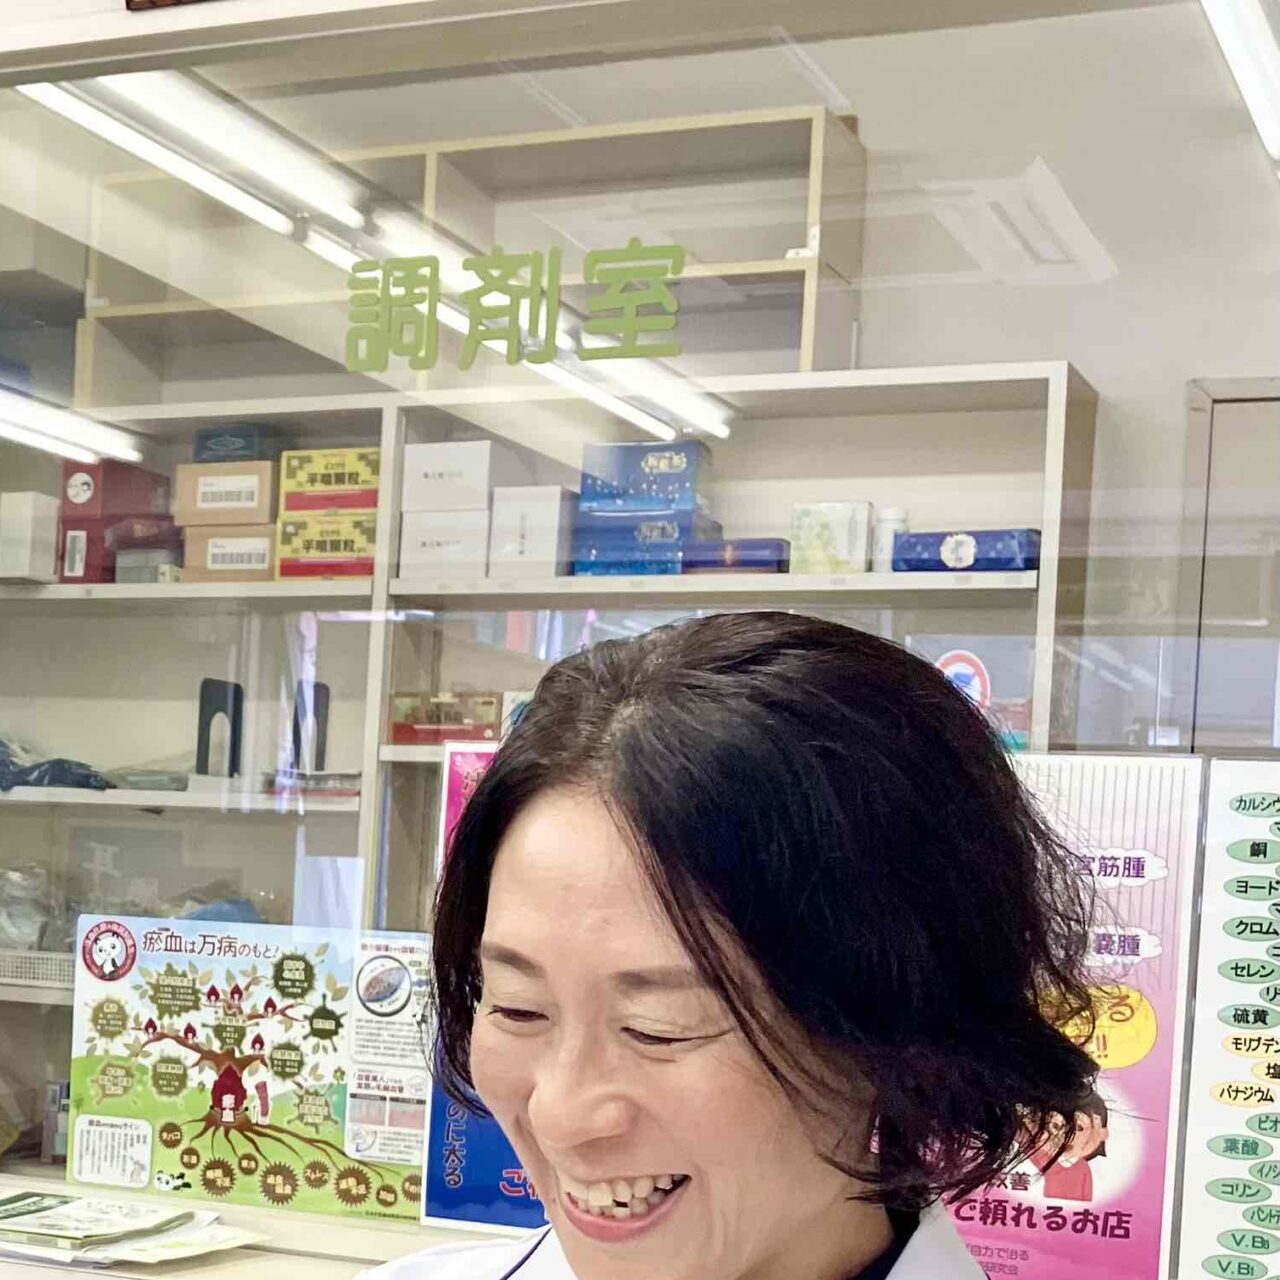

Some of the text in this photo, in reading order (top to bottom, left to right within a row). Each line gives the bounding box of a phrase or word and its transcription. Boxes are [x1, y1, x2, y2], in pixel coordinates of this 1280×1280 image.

[345, 236, 686, 372] 調剤室
[1249, 842, 1267, 858] 銅
[1235, 920, 1279, 936] クロム
[1230, 962, 1276, 979] セレン
[1232, 1008, 1270, 1026] 硫黄
[1220, 1086, 1275, 1103] バナジウム
[1223, 1138, 1260, 1156] 葉酸
[1221, 1183, 1261, 1198] コリン
